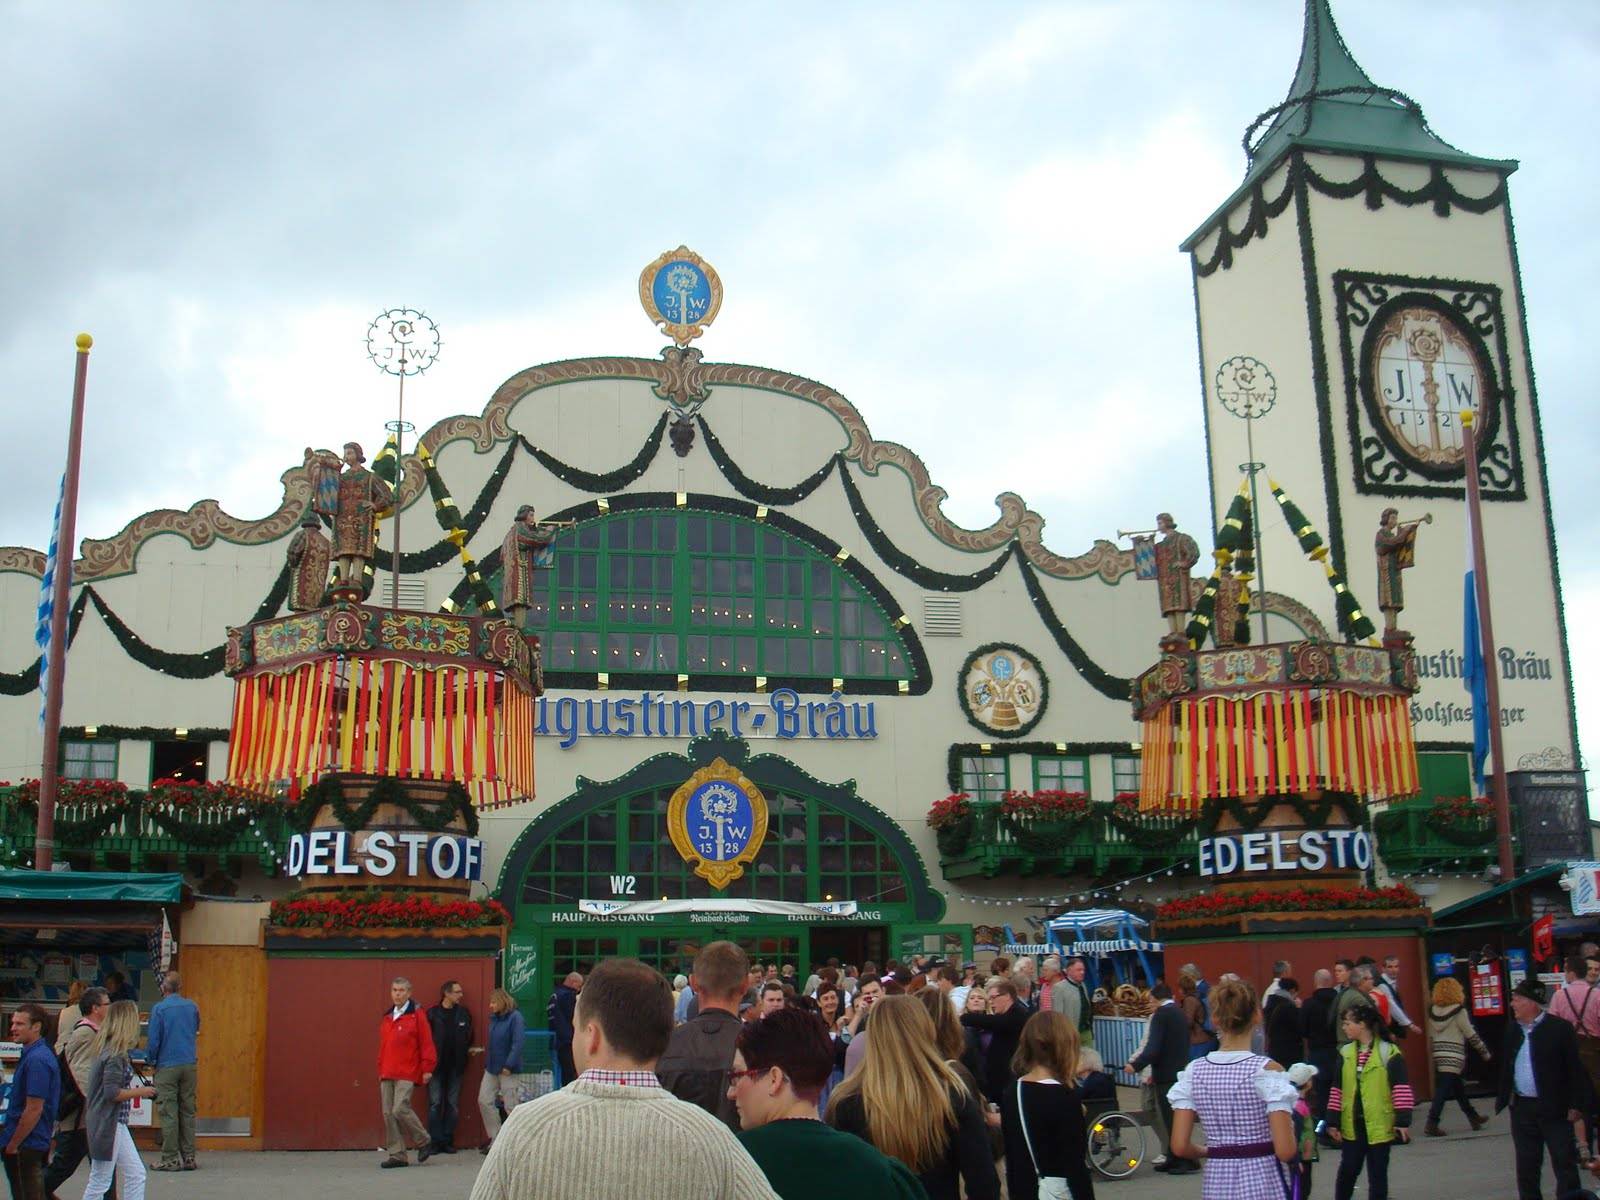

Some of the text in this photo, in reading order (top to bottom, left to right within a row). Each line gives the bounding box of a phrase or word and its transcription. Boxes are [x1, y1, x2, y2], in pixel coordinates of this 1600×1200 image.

[689, 297, 706, 309] W.
[667, 310, 700, 319] 13 28
[383, 347, 427, 359] J W
[1383, 369, 1479, 408] J. W.
[1498, 647, 1552, 680] Bräu
[698, 826, 747, 840] J. W.
[699, 842, 739, 854] 13 28
[1199, 831, 1370, 877] EDELSTO
[610, 875, 635, 895] W2
